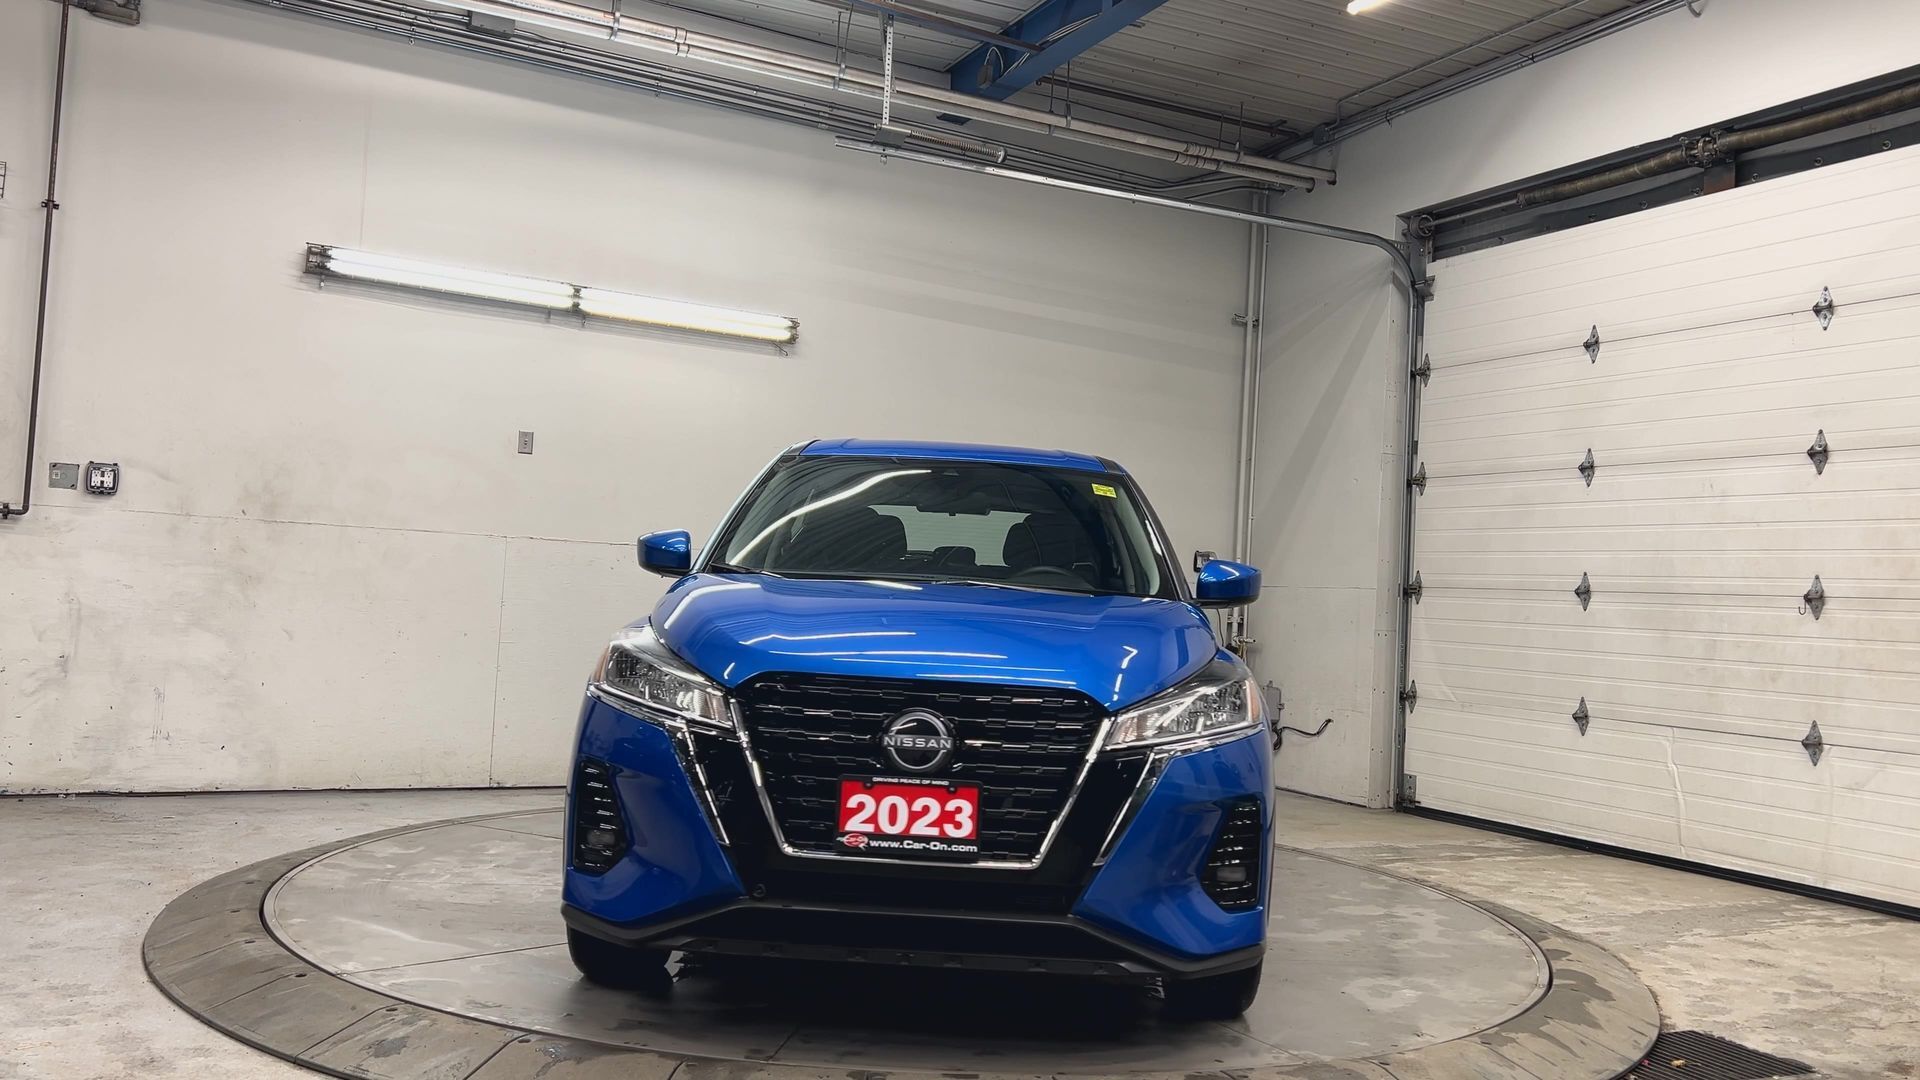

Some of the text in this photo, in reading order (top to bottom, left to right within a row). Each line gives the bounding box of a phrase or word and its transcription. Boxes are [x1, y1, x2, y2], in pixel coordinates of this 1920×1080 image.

[883, 736, 951, 749] NISSAN
[844, 793, 974, 838] 2023
[869, 839, 978, 853] www.Car-On.com
